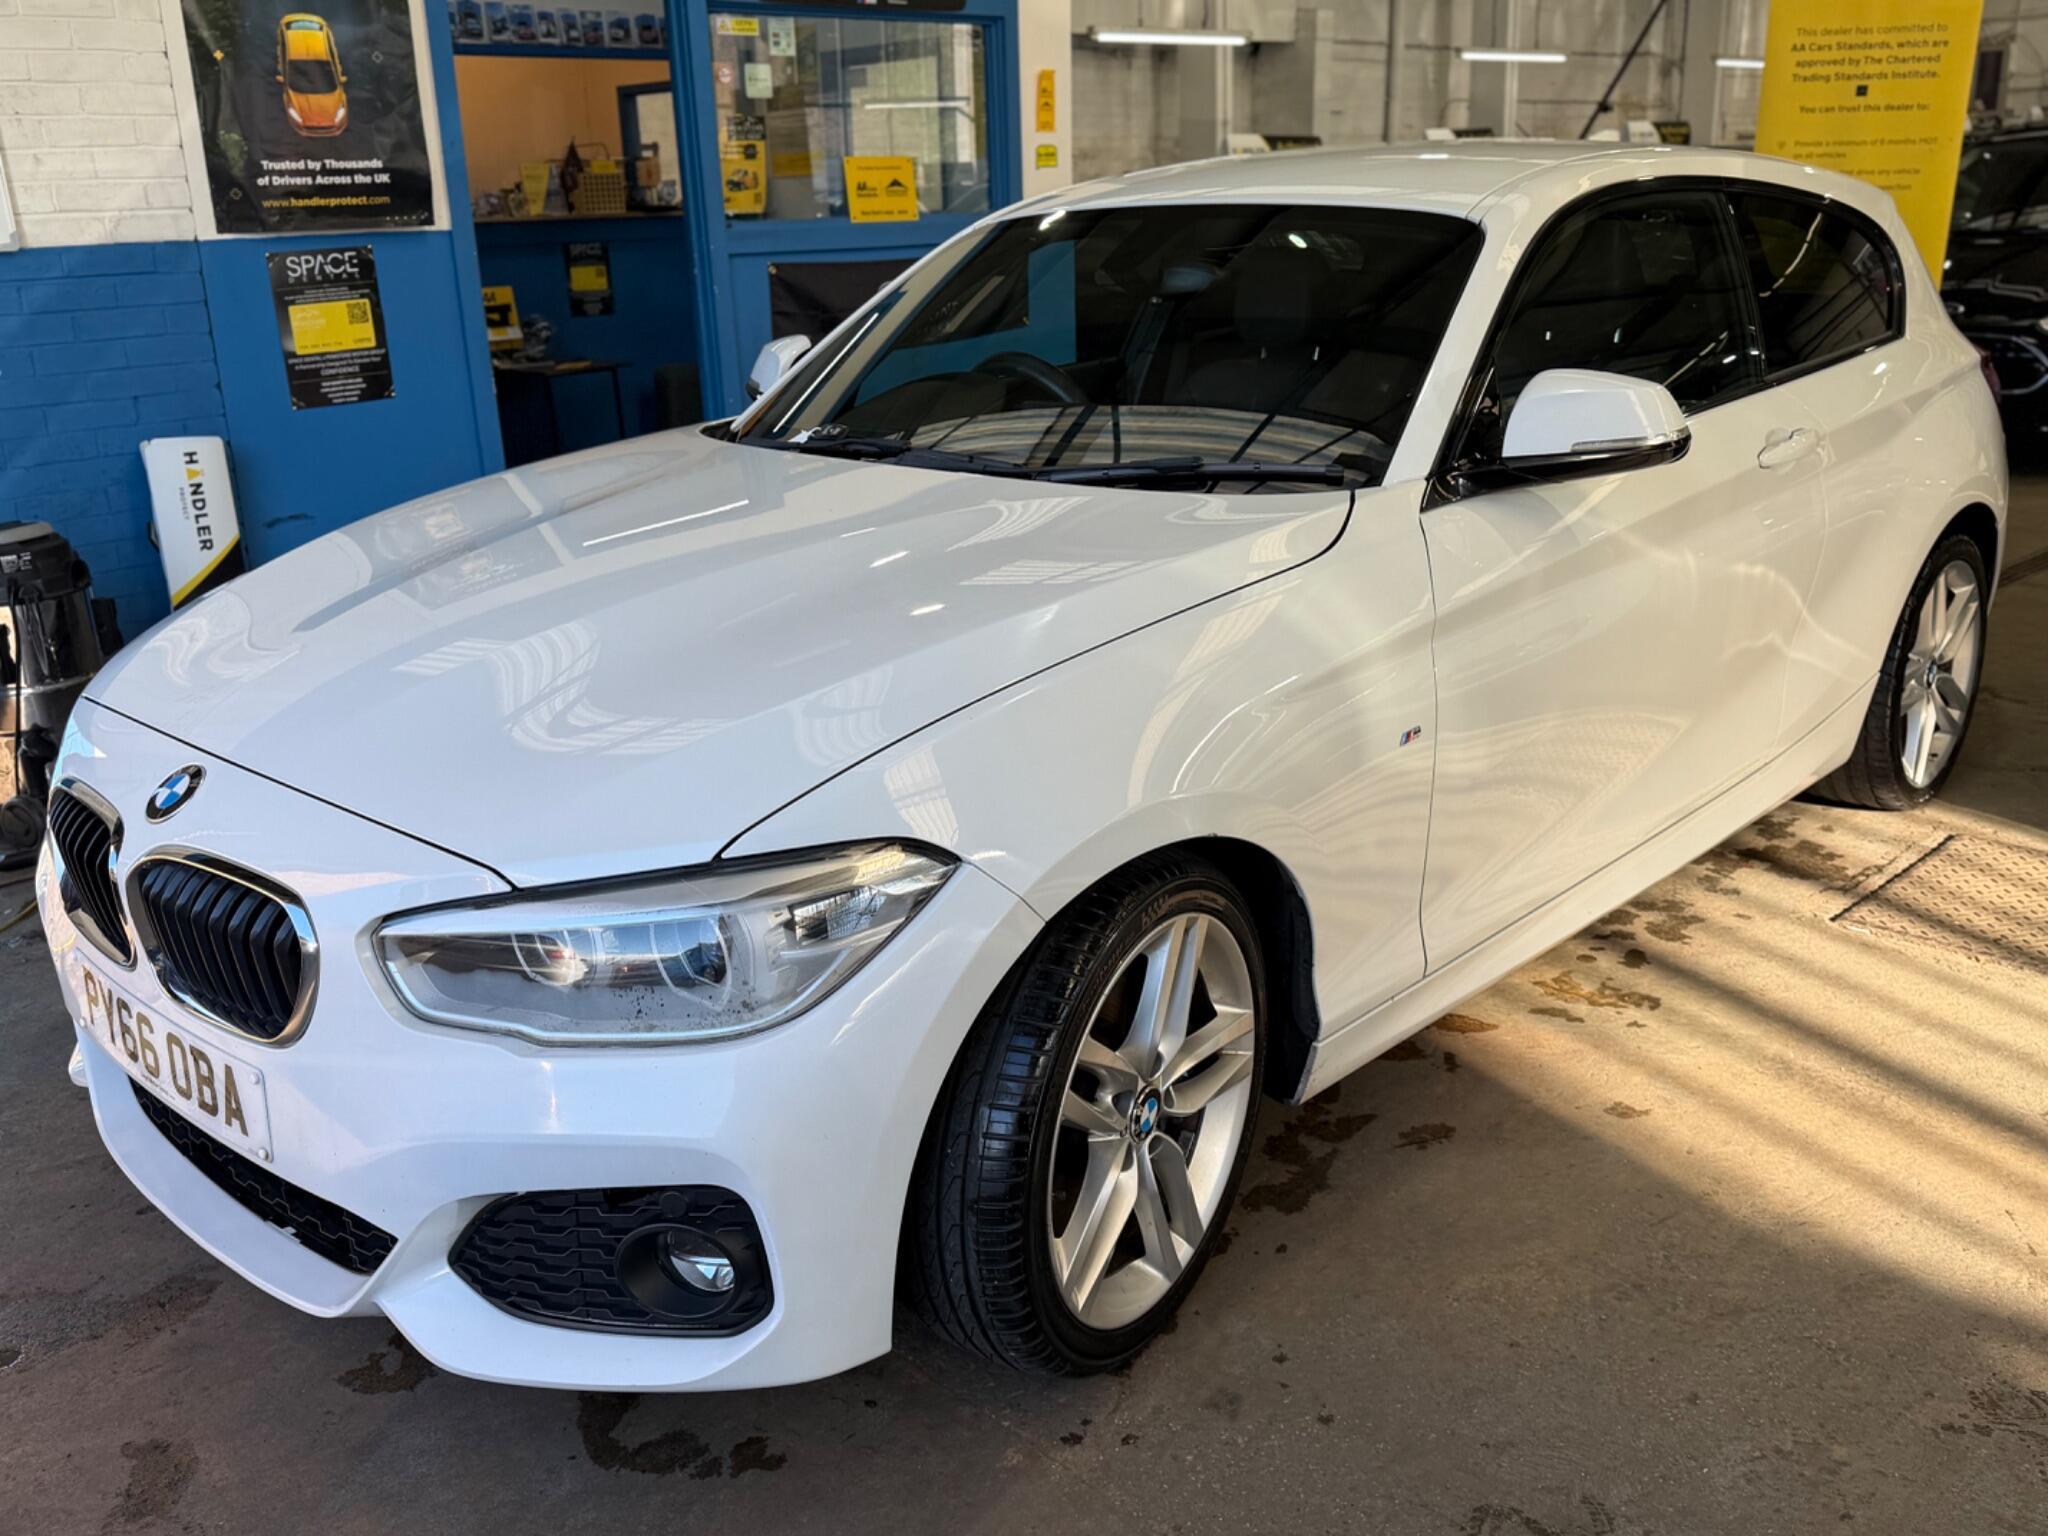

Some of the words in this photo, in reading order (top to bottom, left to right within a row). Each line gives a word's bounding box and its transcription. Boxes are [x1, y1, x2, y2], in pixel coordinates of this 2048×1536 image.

[1797, 27, 1818, 37] This
[1820, 26, 1853, 36] dealer
[1855, 25, 1874, 35] has
[1876, 23, 1935, 34] committed
[1936, 23, 1949, 33] to
[1791, 43, 1806, 53] AA
[1808, 42, 1833, 52] Cars
[1896, 39, 1930, 49] which
[1932, 39, 1949, 48] are
[1795, 57, 1846, 68] approved
[1848, 56, 1861, 67] by
[1864, 55, 1884, 65] The
[1886, 54, 1941, 64] Chartered
[1792, 73, 1831, 84] Trading
[1834, 71, 1889, 81] Standards
[1799, 105, 1817, 114] You
[1819, 105, 1836, 113] can
[1838, 103, 1862, 113] trust
[1863, 102, 1881, 112] this
[1883, 101, 1914, 111] dealer
[260, 160, 306, 170] Trusted
[307, 159, 322, 171] by
[324, 158, 384, 169] Thousands
[256, 175, 270, 186] of
[271, 174, 313, 186] Drivers
[315, 173, 352, 185] Across
[353, 173, 373, 184] the
[374, 173, 391, 184] UK
[262, 195, 391, 208] www.handlerprotect.com
[286, 251, 360, 277] SPACE
[81, 964, 160, 1080] PY66
[166, 1031, 249, 1138] OBA
